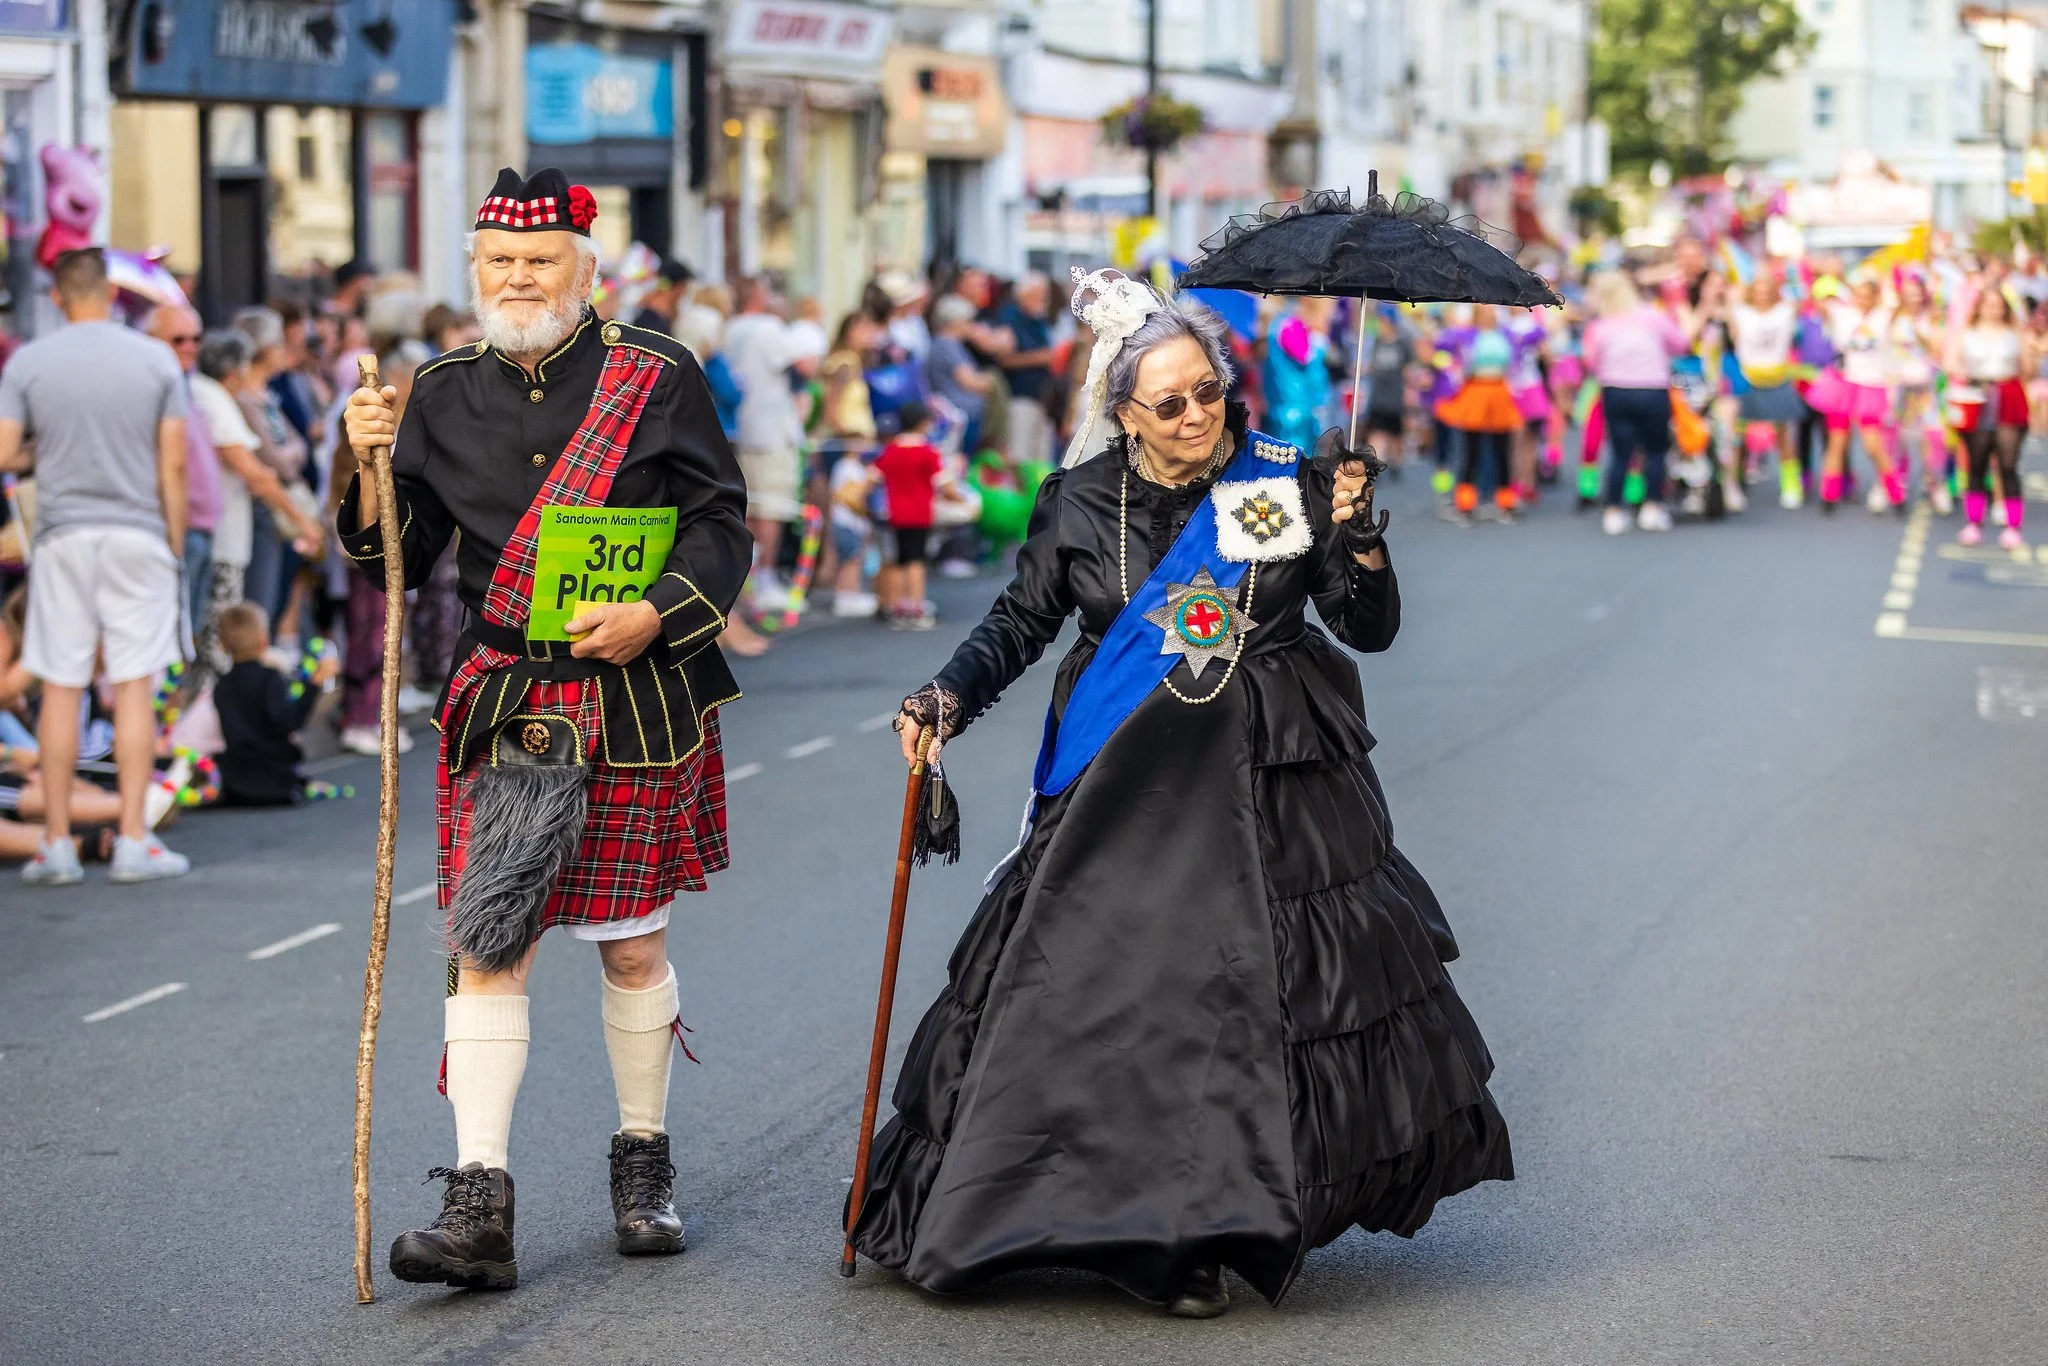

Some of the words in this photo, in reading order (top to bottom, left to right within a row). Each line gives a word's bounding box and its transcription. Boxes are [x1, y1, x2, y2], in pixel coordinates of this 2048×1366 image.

[555, 512, 608, 525] Sandown
[610, 514, 637, 526] Main
[639, 513, 671, 526] Carnival
[585, 534, 646, 572] 3rd
[556, 573, 654, 610] Plac
